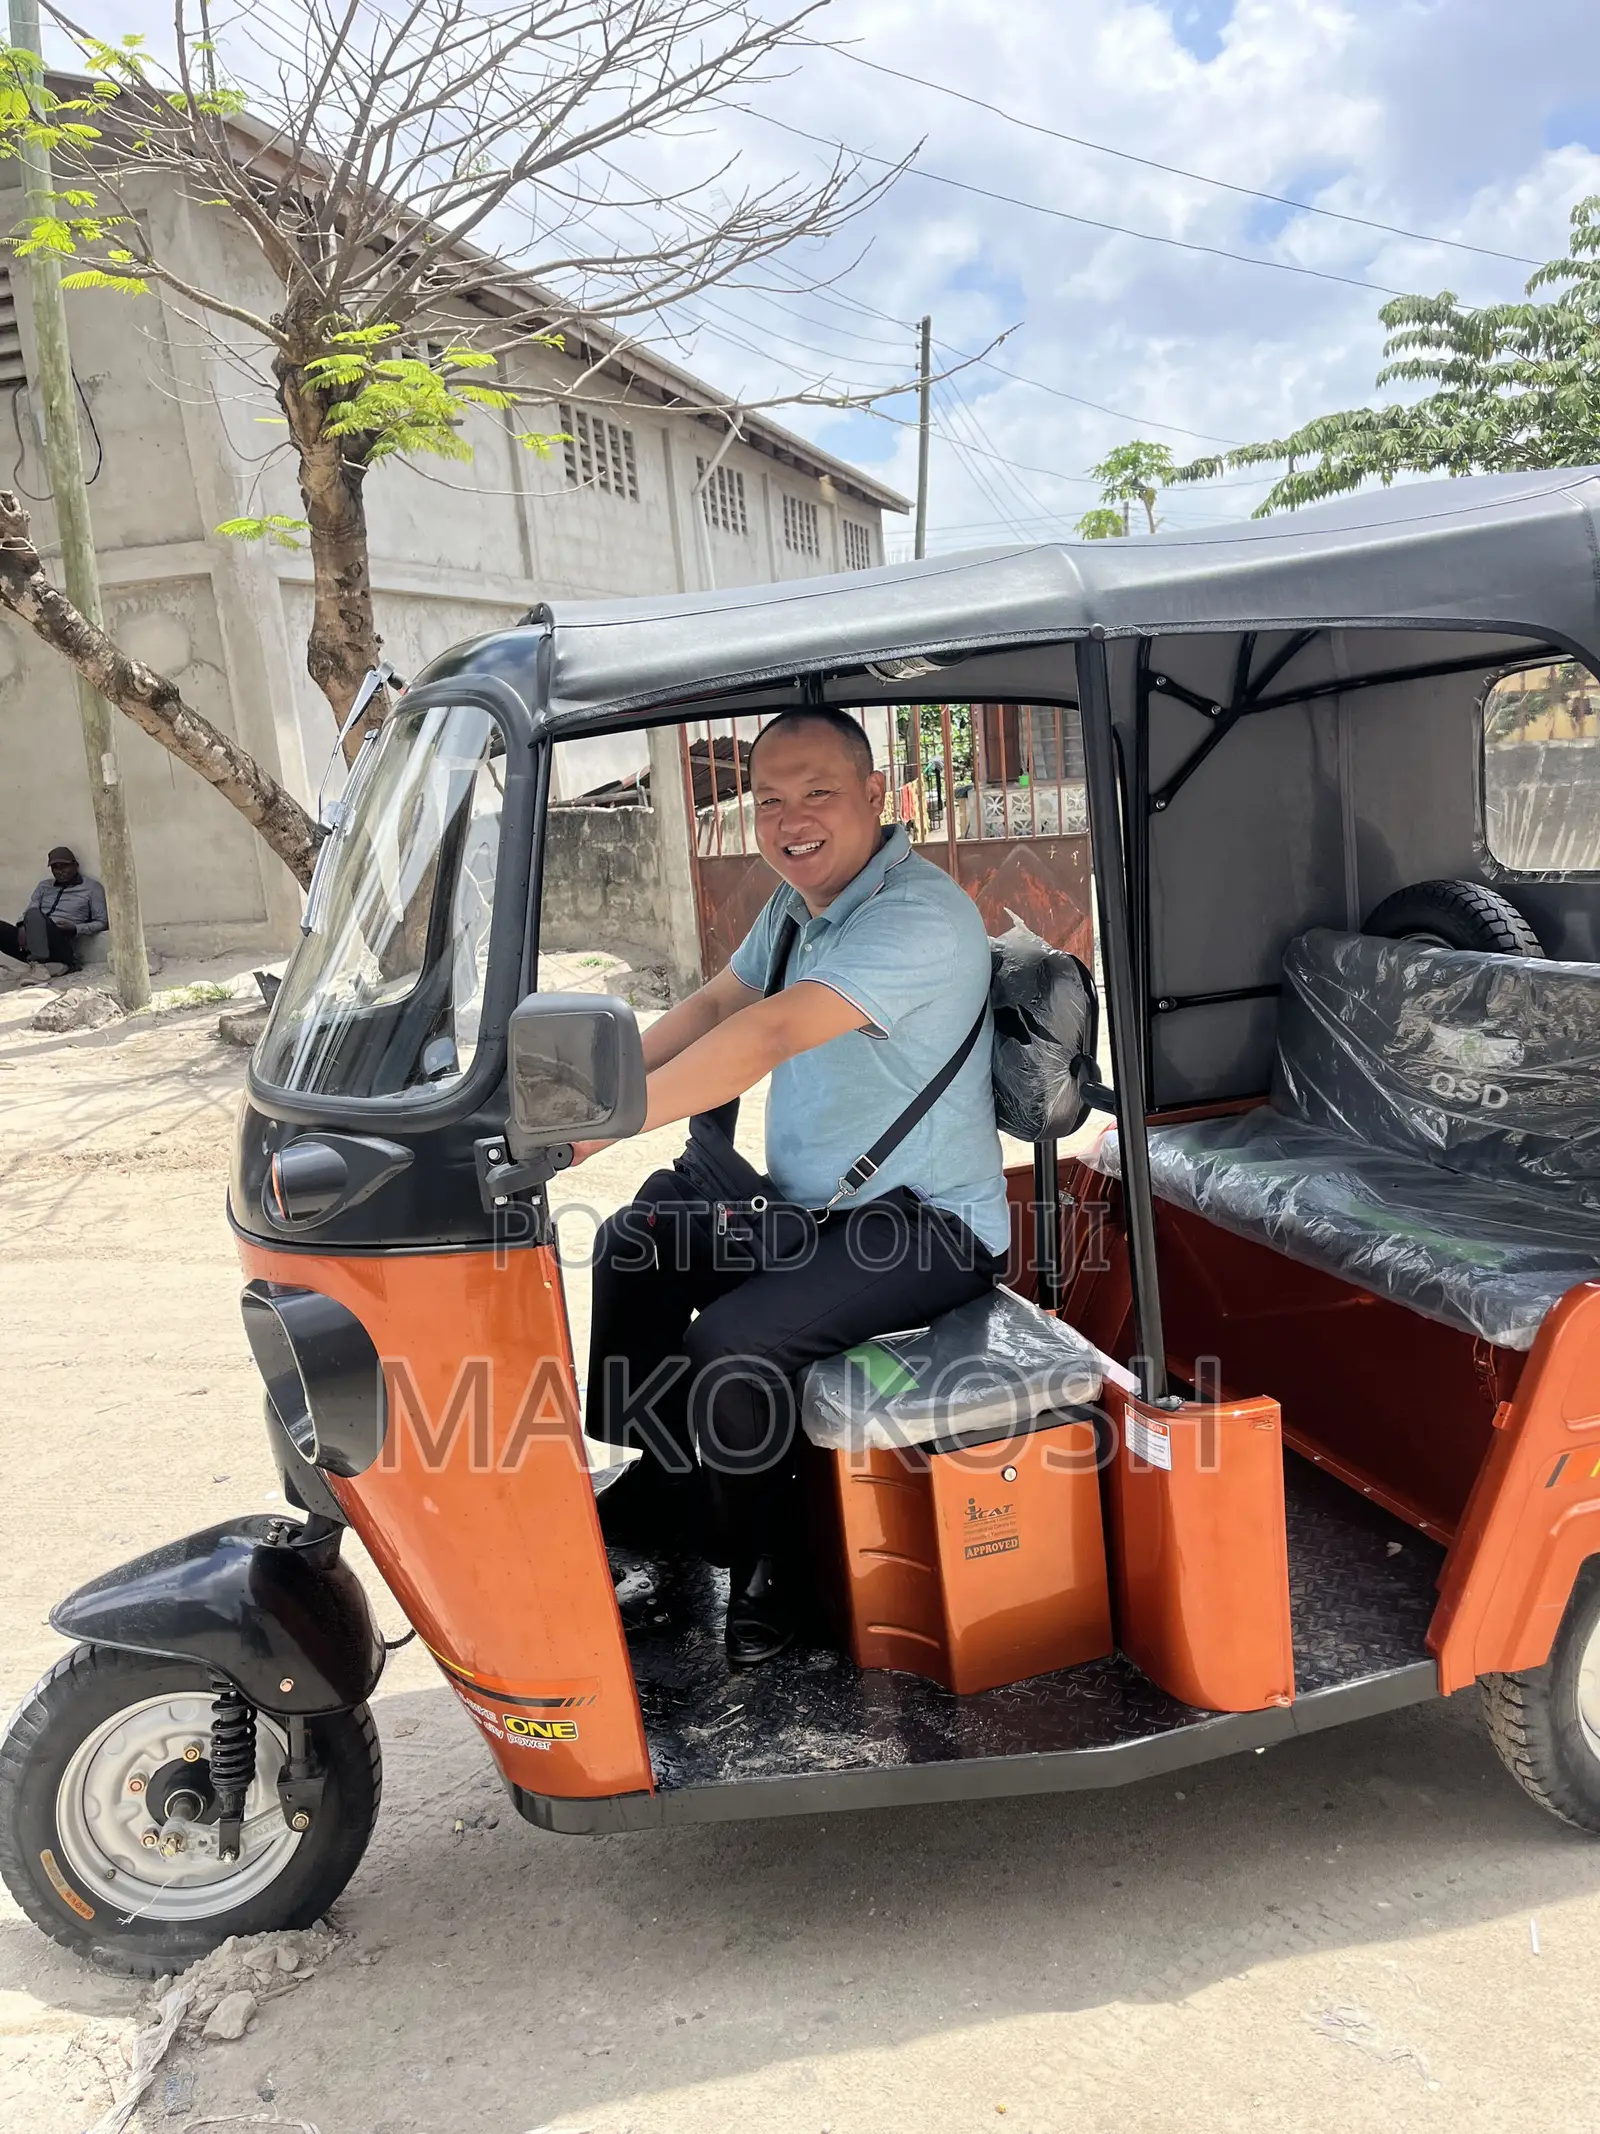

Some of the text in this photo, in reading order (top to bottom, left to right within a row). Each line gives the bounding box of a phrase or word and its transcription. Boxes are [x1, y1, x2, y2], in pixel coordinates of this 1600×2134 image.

[966, 1537, 1019, 1558] APPROVED
[505, 1717, 577, 1739] ONE
[507, 1733, 552, 1750] power
